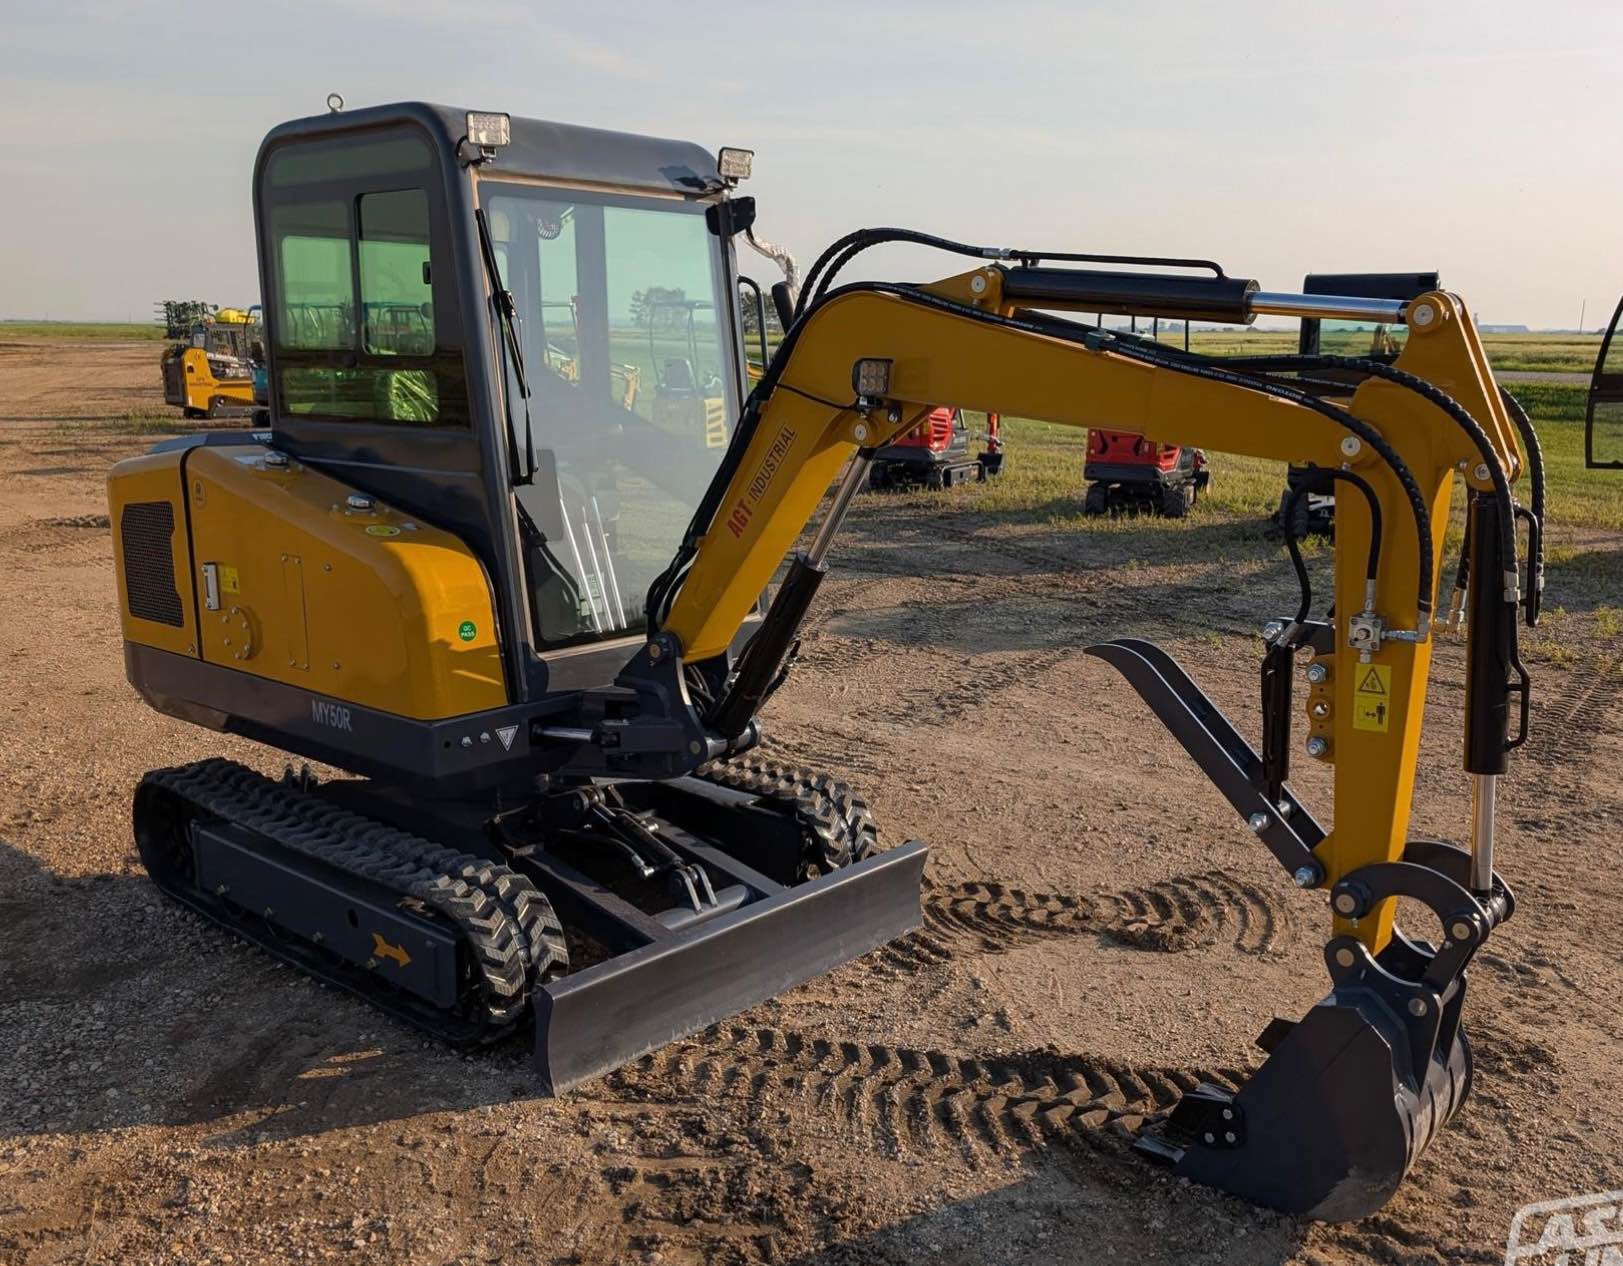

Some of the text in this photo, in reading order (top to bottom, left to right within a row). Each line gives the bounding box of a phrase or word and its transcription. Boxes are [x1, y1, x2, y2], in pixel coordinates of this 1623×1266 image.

[726, 427, 796, 539] AGT INDUSTRIAL
[311, 699, 352, 732] MY50R
